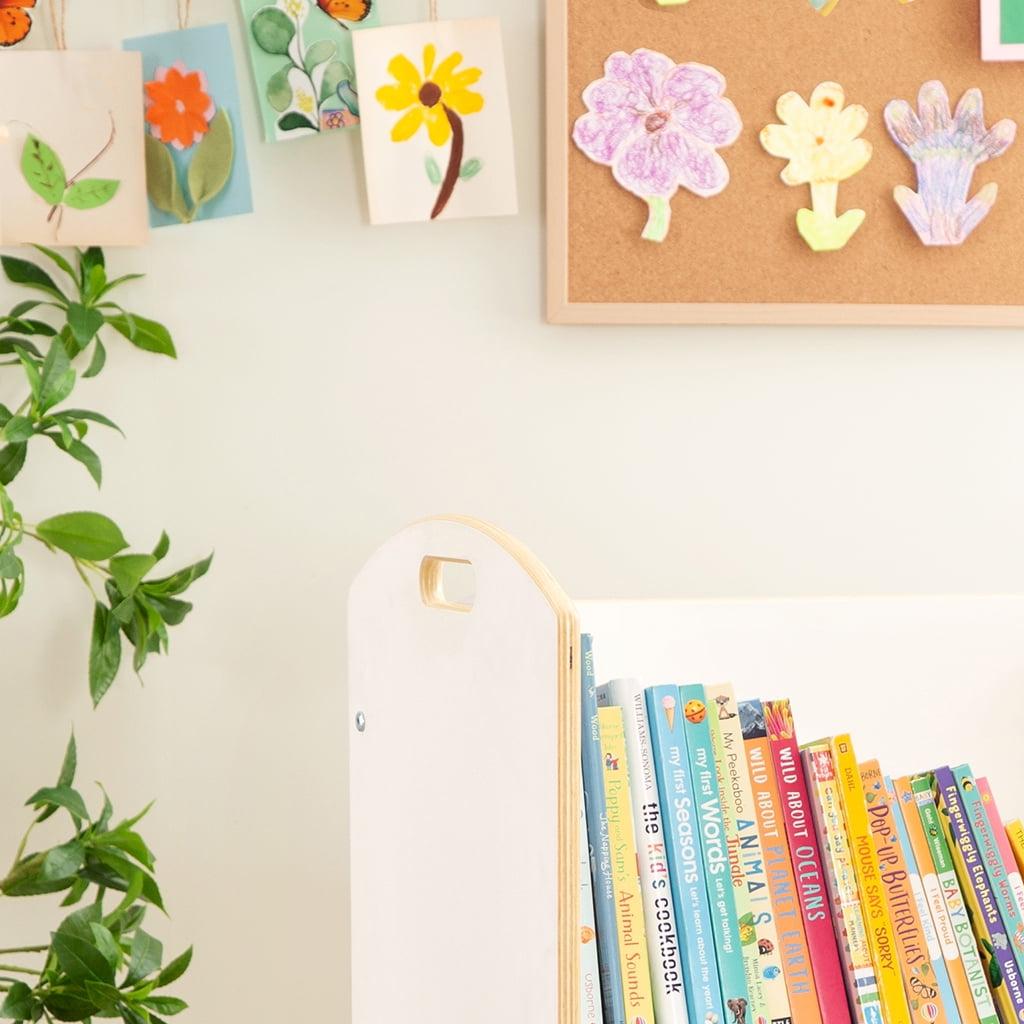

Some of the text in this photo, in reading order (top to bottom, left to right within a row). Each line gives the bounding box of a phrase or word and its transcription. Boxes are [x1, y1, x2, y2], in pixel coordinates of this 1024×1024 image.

[584, 650, 594, 677] Wood
[589, 715, 600, 741] Wood
[633, 694, 653, 791] WILLIAMS-SONOMA
[669, 746, 681, 765] my
[723, 732, 735, 750] My
[607, 779, 625, 824] Poppy
[673, 769, 688, 795] first
[725, 753, 745, 814] Peekaboo
[844, 767, 856, 792] DAHL
[673, 797, 700, 884] Seasons
[695, 747, 736, 953] my first Words Let's get talking!
[778, 747, 826, 922] WILD ABOUT OCEANS
[933, 837, 947, 868] Wiseman
[945, 785, 999, 924] Fingerwiggly Elephants
[748, 747, 810, 996] WILD ABOUT PLANET EARTH
[856, 835, 877, 881] MOUSE
[970, 800, 1017, 918] Fingerwiggly Worms
[642, 802, 682, 995] the kid's cookbook
[689, 887, 701, 906] Let's
[866, 884, 883, 918] SAYS
[932, 893, 944, 913] Feel
[938, 915, 952, 945] Proud
[692, 909, 706, 935] learn
[942, 878, 991, 1010] BABY BOTANIST
[618, 890, 647, 1008] Animal Sounds
[696, 937, 710, 965] about
[583, 973, 597, 1019] Usborne
[701, 967, 712, 982] the
[1003, 959, 1024, 1005] Usborne
